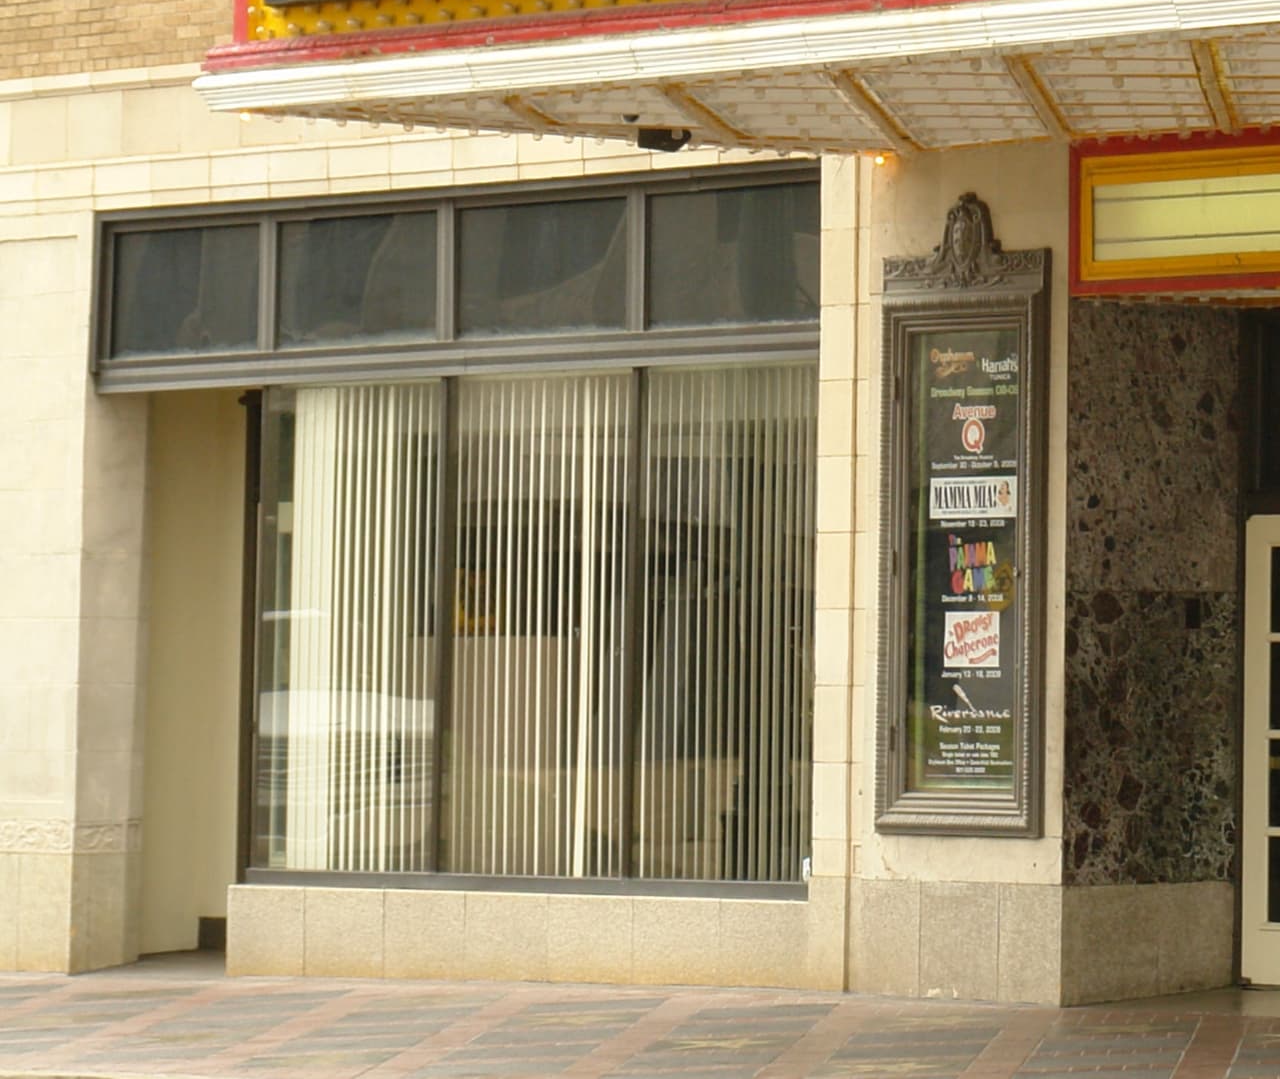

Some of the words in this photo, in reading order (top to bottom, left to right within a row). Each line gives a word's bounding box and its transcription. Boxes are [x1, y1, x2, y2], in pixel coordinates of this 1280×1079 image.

[952, 402, 997, 420] Avenue
[962, 418, 985, 454] Q
[934, 485, 972, 509] MAMMA
[973, 485, 997, 509] MIA!
[945, 633, 998, 659] Chaperone
